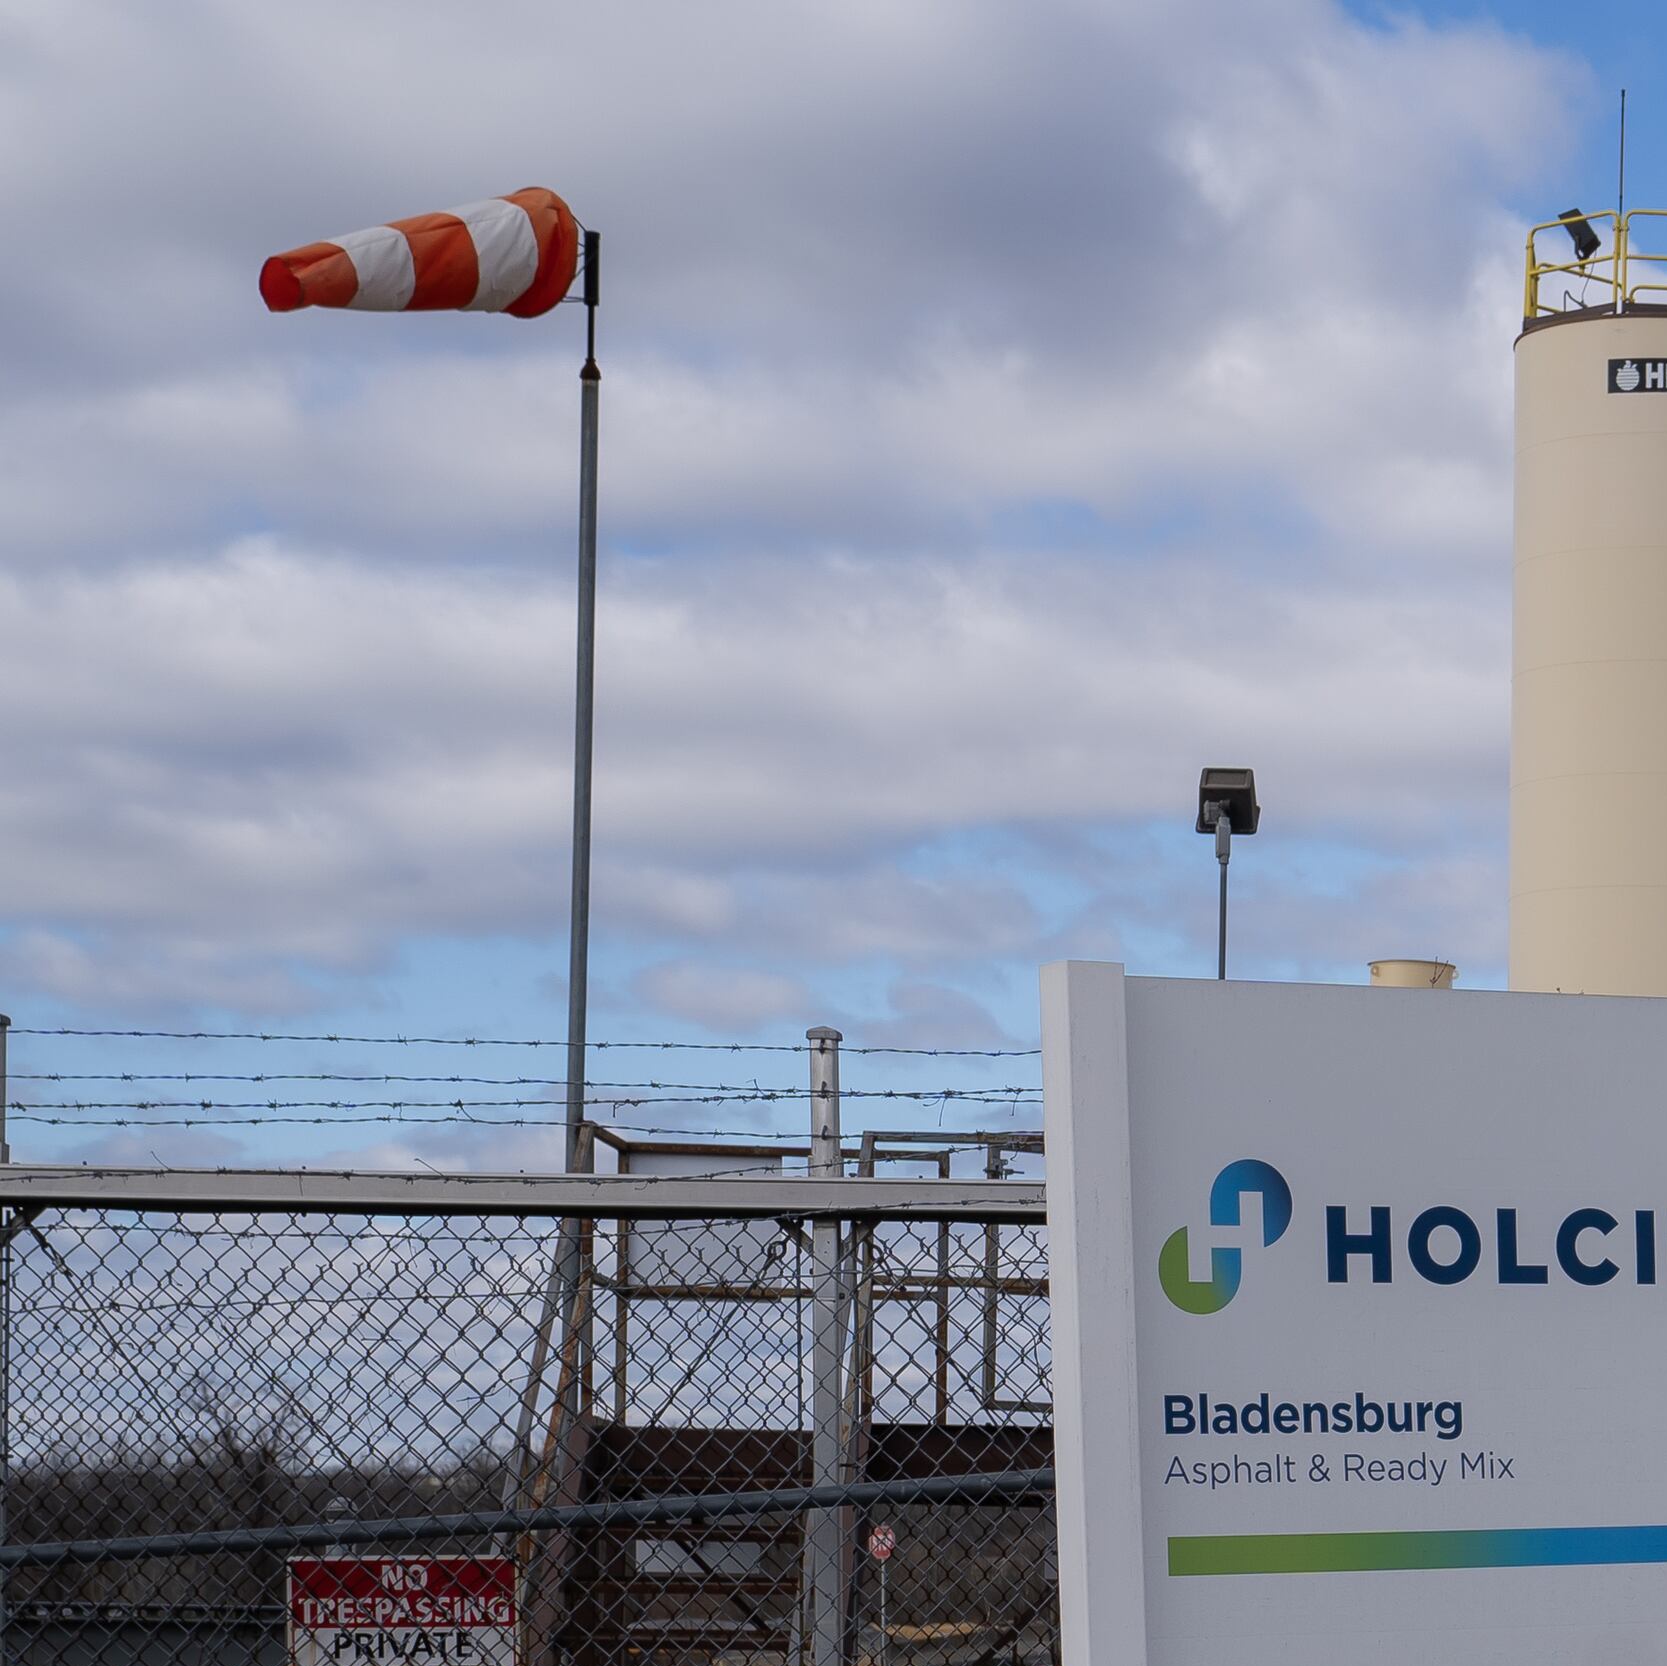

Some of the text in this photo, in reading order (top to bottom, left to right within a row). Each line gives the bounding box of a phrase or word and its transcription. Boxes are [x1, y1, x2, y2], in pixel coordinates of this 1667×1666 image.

[1164, 1392, 1463, 1440] Bladensburg
[1164, 1451, 1515, 1489] Asphalt & Ready Mix
[381, 1564, 428, 1591] NO
[298, 1596, 510, 1624] TRESPASSING
[334, 1632, 473, 1659] PRIVATE
